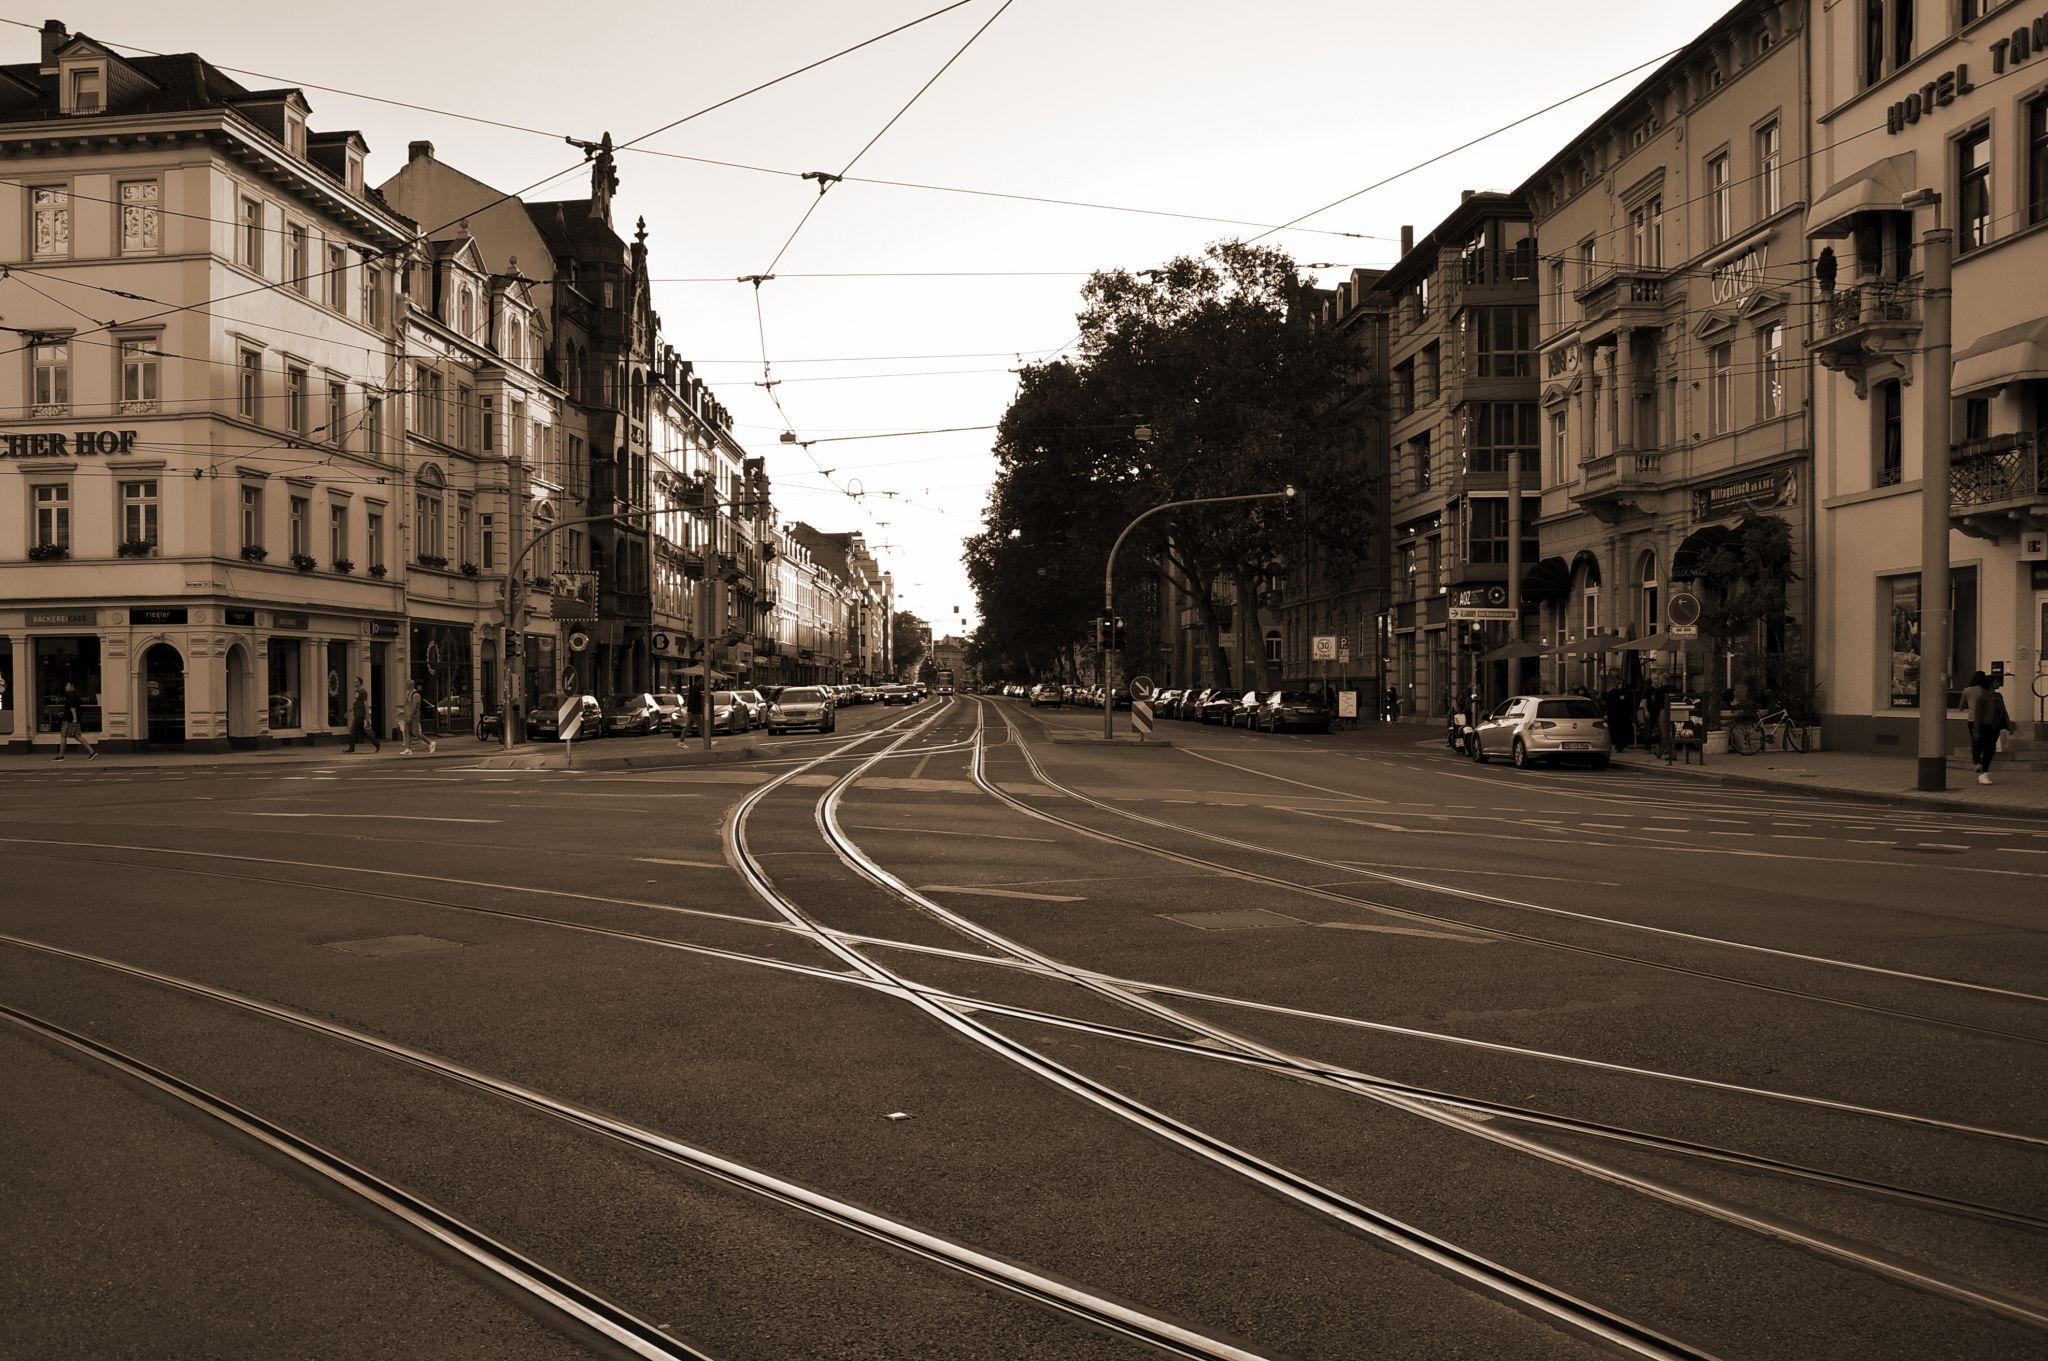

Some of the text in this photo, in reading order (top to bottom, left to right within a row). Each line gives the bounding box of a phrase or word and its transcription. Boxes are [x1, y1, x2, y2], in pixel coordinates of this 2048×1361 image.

[1887, 64, 1975, 135] HOTEL
[75, 430, 138, 456] HOF
[1711, 480, 1750, 501] Mittagstisch
[145, 610, 171, 620] riegler
[1320, 641, 1330, 650] 30
[1341, 638, 1348, 649] P
